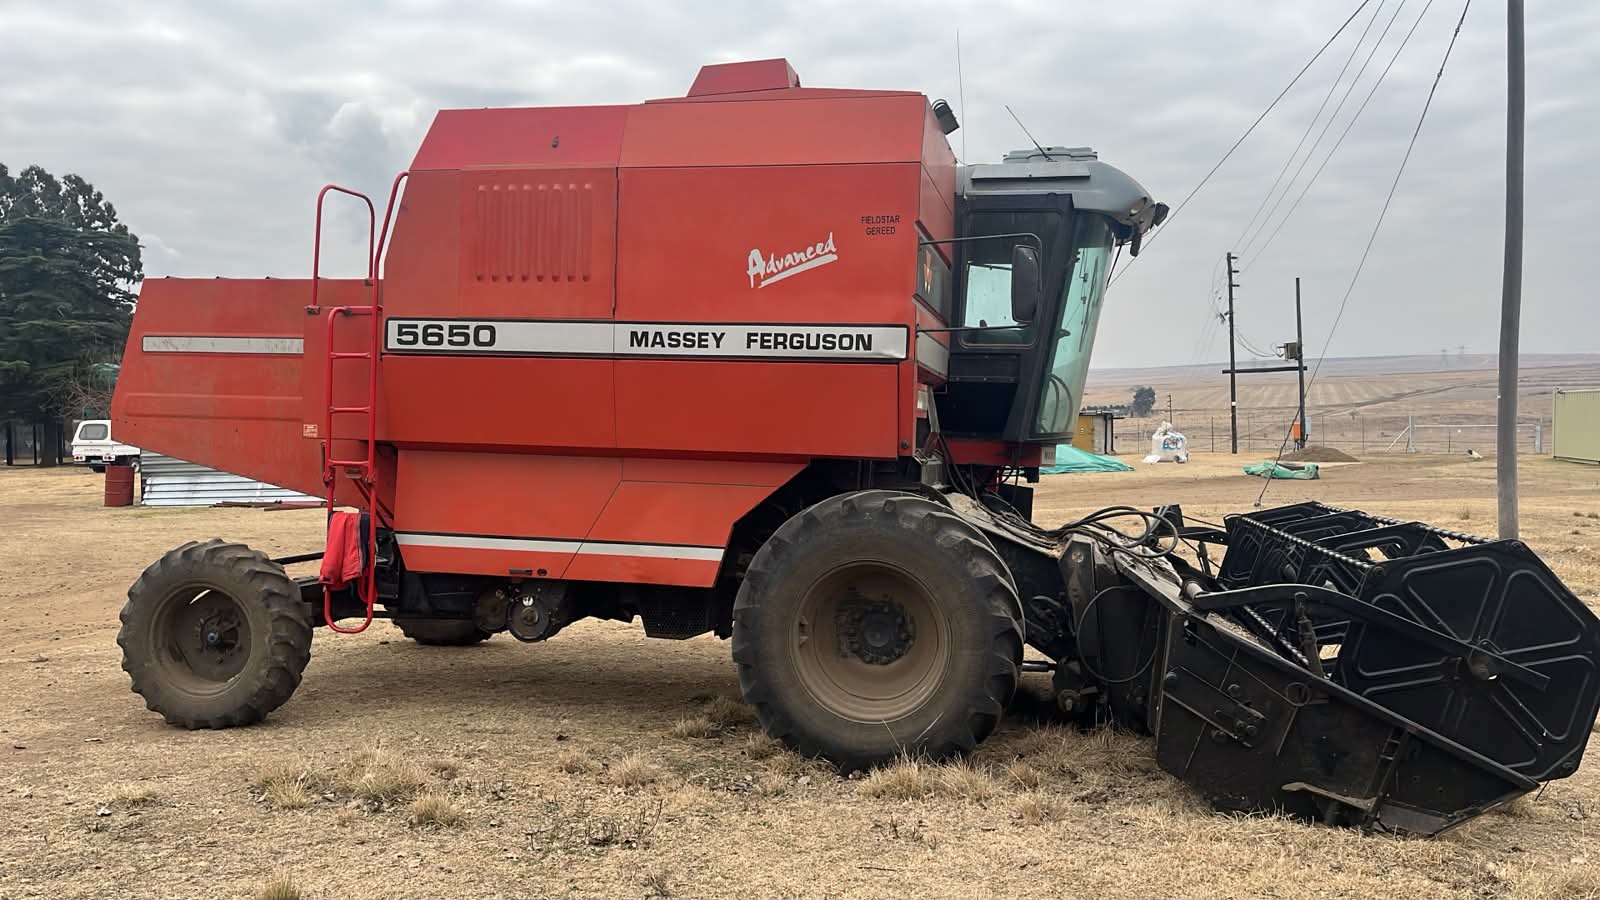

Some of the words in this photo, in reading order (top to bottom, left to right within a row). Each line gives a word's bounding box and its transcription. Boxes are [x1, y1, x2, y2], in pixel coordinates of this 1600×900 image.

[861, 215, 901, 225] FIELDSTAR
[865, 226, 896, 236] GEREED
[746, 231, 838, 289] Advanced
[396, 323, 496, 347] 5650
[629, 331, 726, 349] MASSEY
[746, 333, 873, 351] FERGUSON
